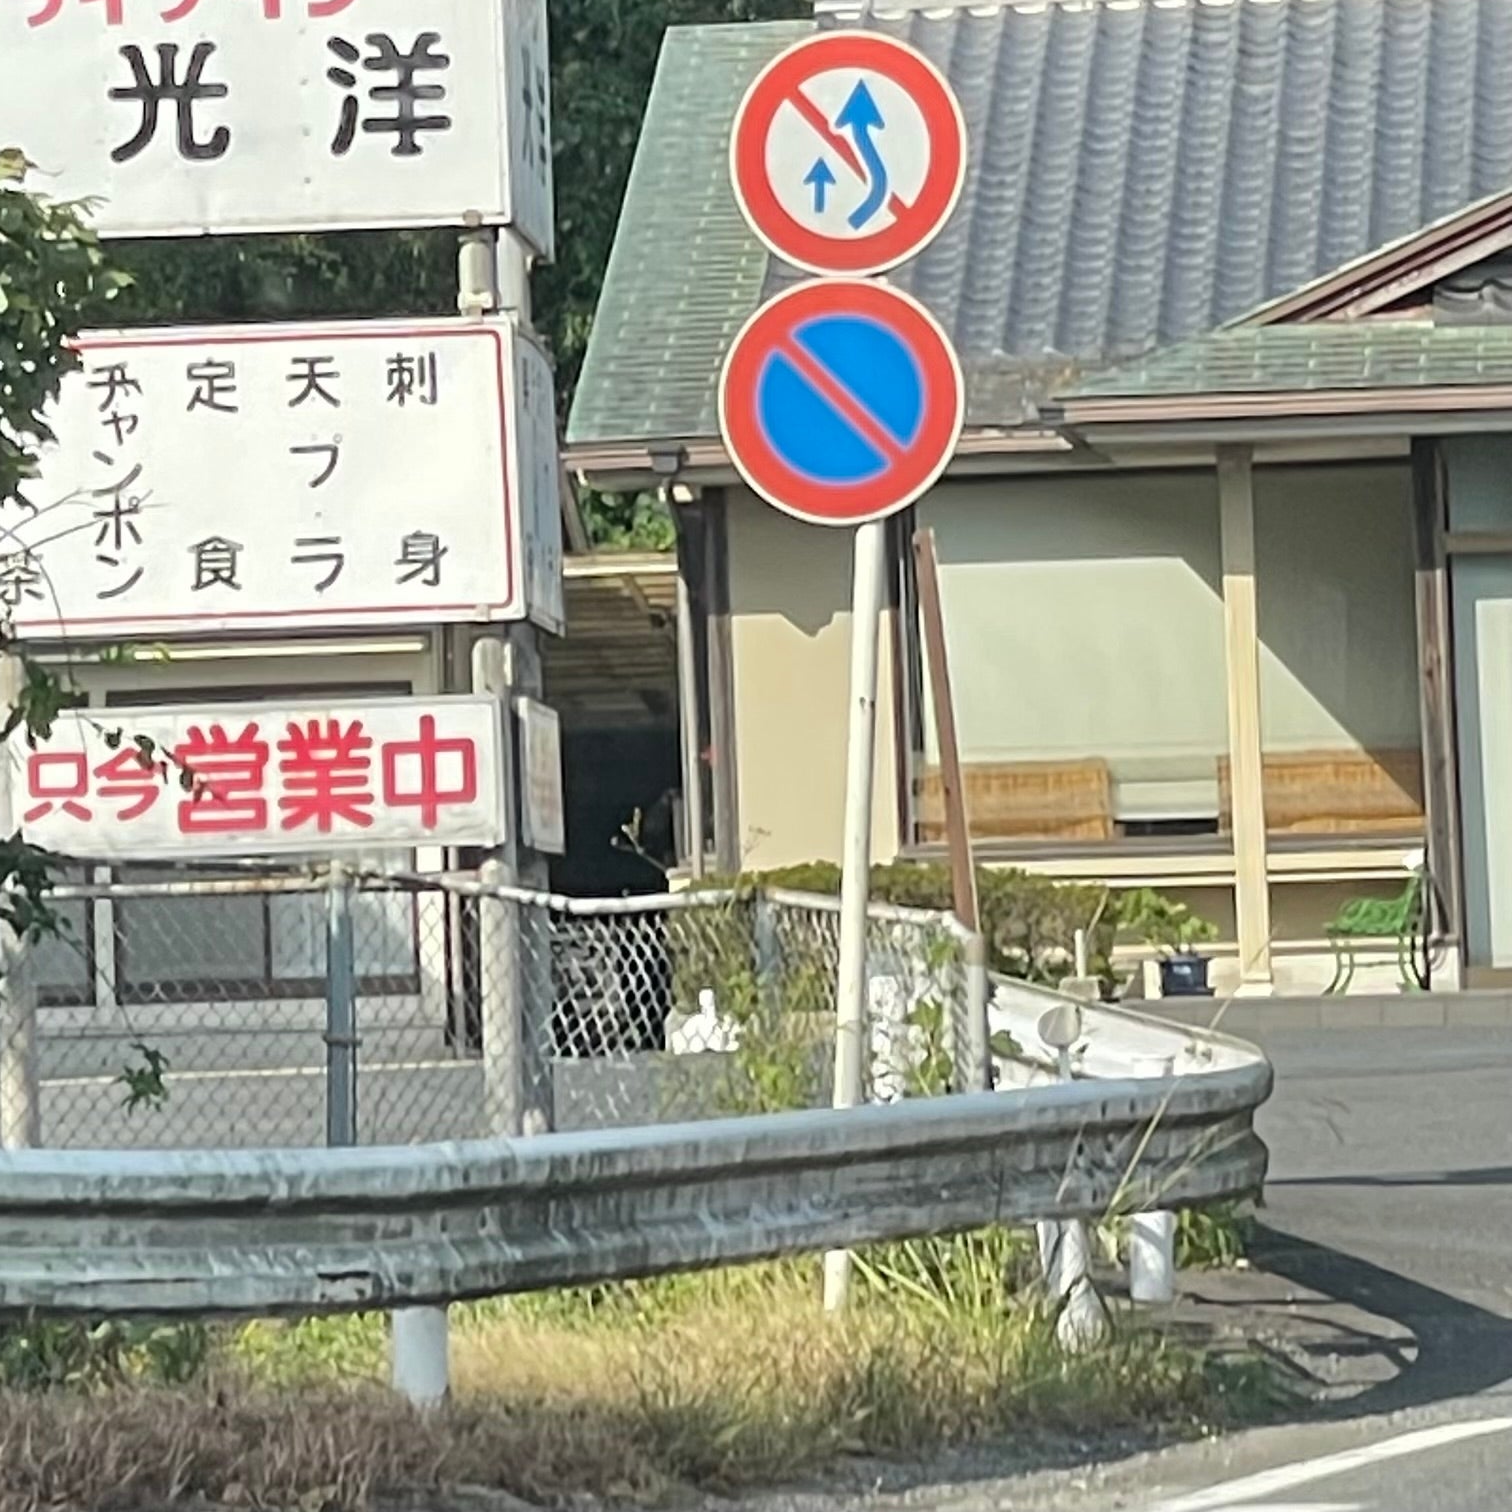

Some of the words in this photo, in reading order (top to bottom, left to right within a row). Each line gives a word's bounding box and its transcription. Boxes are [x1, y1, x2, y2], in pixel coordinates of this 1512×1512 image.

[107, 31, 451, 163] 光洋
[86, 362, 144, 599] チャンポン
[187, 356, 245, 592] 定食
[286, 356, 346, 593] 天プラ
[386, 352, 449, 588] 刺身
[23, 715, 477, 832] 只今営業中
